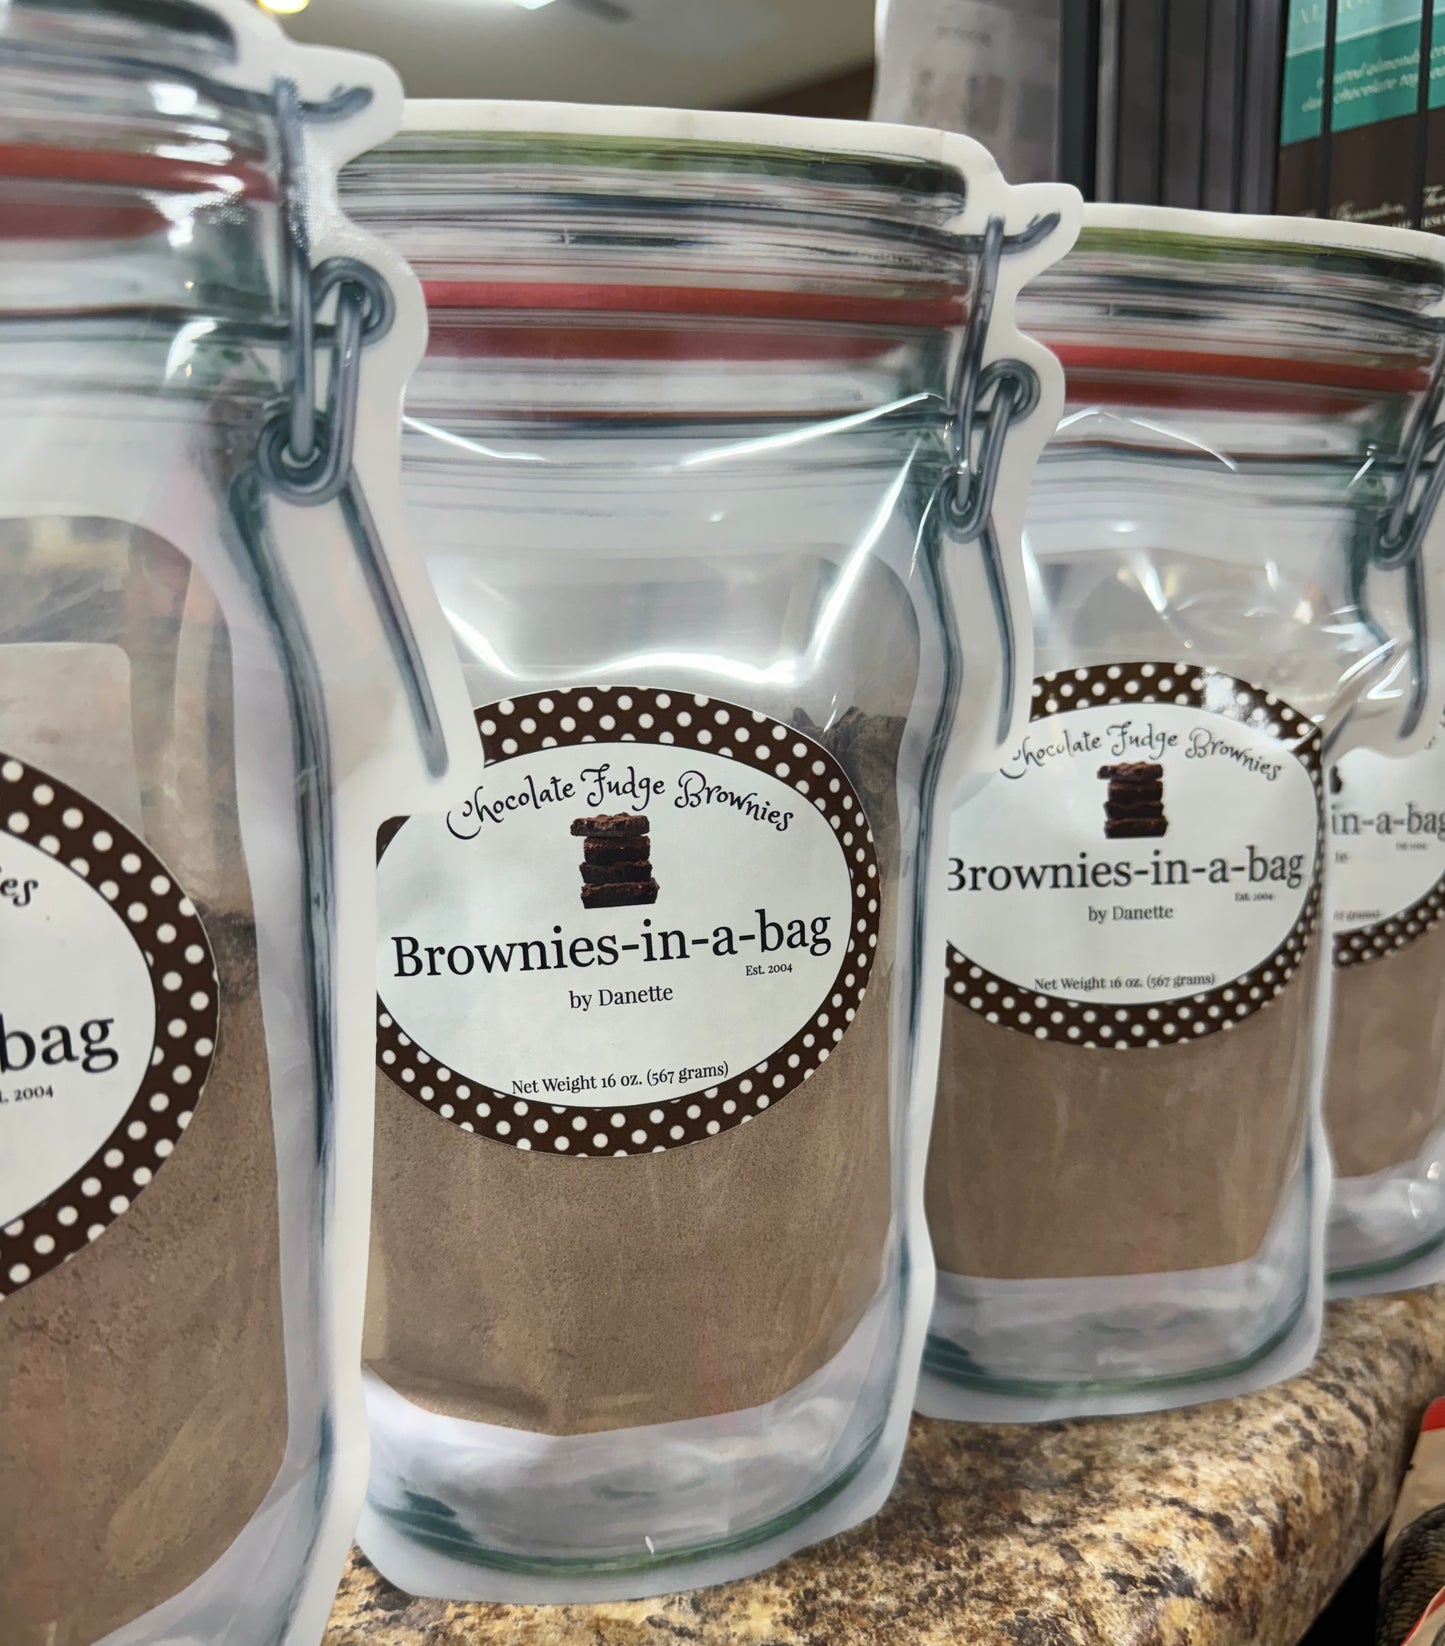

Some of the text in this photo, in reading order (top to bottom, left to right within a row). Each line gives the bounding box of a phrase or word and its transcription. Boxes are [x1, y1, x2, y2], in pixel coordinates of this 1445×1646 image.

[1106, 721, 1178, 760] Fudge
[1185, 727, 1283, 781] Brownies
[580, 763, 666, 811] Fudge
[674, 770, 794, 831] Brownies
[1088, 905, 1174, 924] by Danette
[391, 908, 832, 977] Brownies-in-a-bag
[745, 962, 793, 976] Est. 2004
[1034, 972, 1216, 991] Net Weight 16 oz. (567 grams)
[569, 985, 674, 1011] by Danette
[512, 1061, 729, 1095] Net Weight 16 oz. (567 grams)
[14, 1085, 54, 1101] 2004
